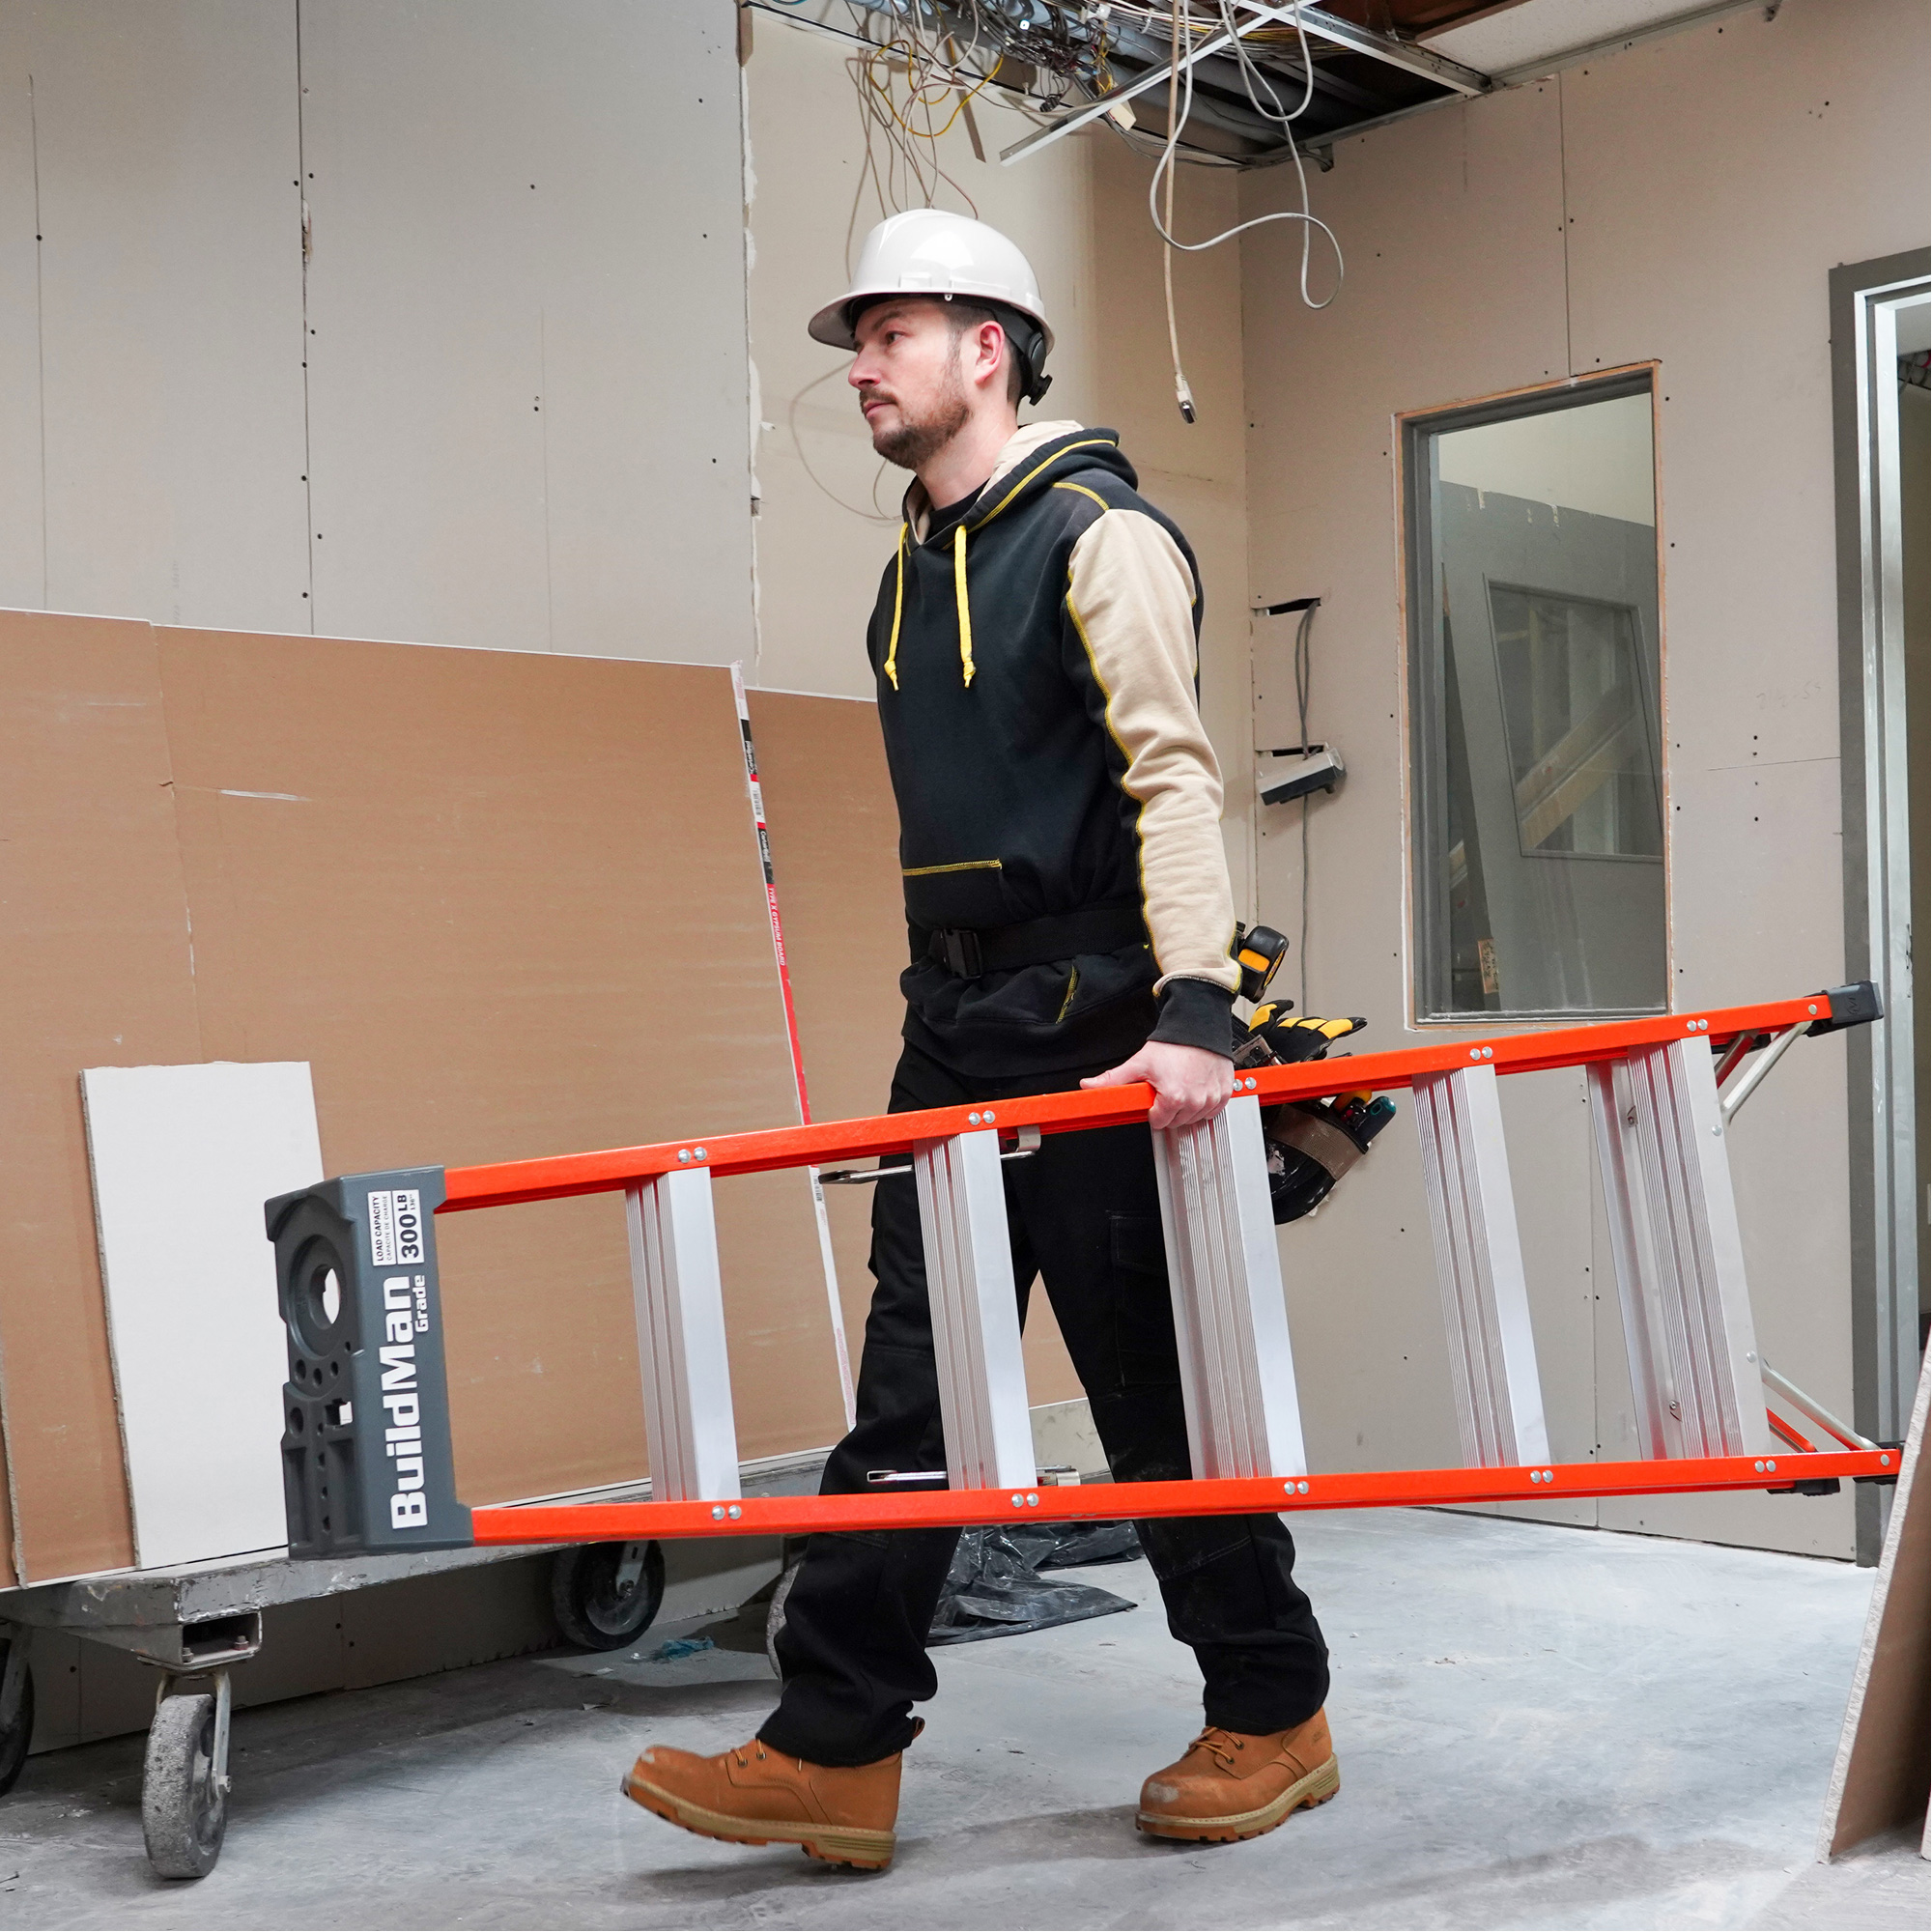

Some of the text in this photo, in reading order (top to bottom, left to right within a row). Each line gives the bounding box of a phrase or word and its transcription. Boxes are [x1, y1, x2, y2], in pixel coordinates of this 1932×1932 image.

[768, 888, 777, 904] TYPE
[772, 911, 782, 941] GYPSUM
[777, 941, 785, 966] BOARD
[372, 1196, 384, 1262] LOAD CAPACITY
[397, 1194, 419, 1259] 300 LB
[412, 1274, 429, 1333] Grade
[379, 1275, 429, 1530] BuildMan
